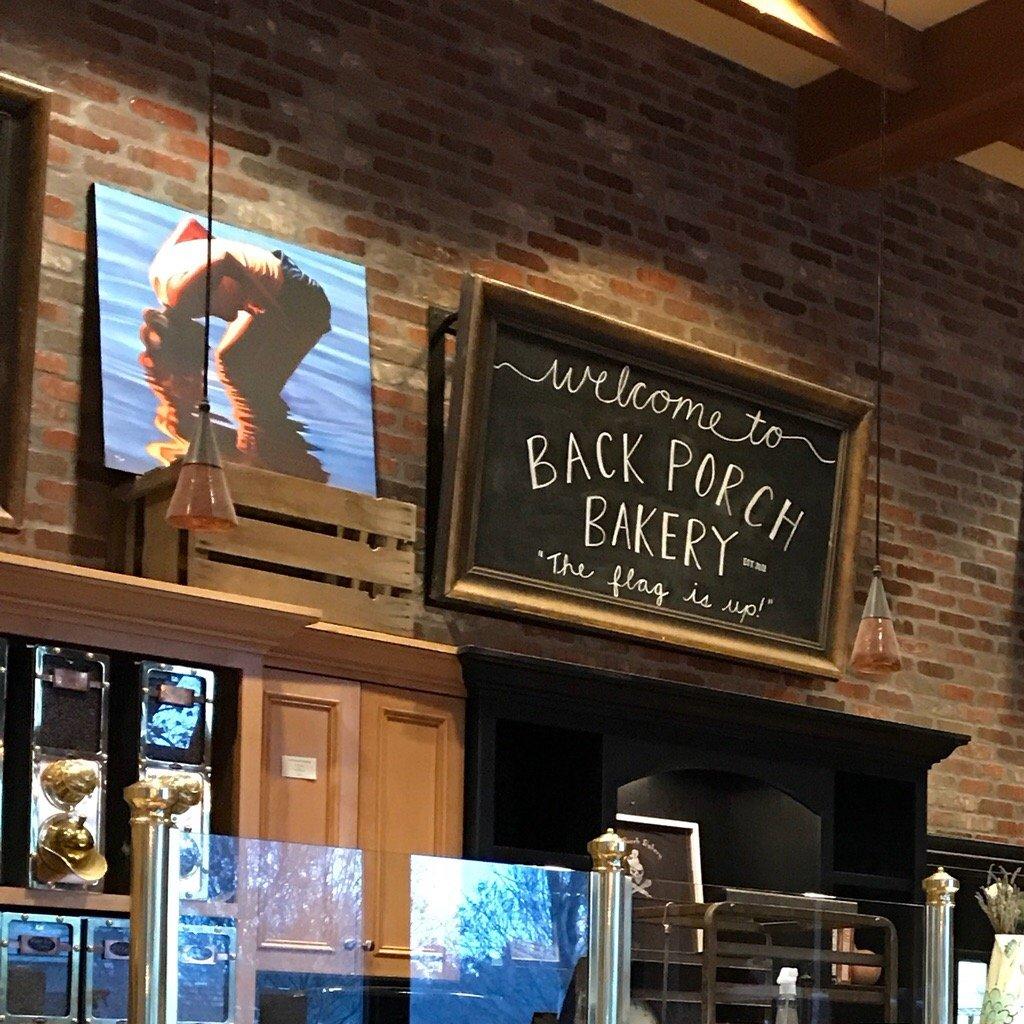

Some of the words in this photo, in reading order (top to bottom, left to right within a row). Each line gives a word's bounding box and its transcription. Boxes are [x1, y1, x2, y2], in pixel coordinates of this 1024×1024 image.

[540, 358, 728, 432] welcome
[745, 409, 793, 450] to
[526, 431, 645, 490] BACK
[667, 438, 805, 552] PORCH
[584, 494, 739, 577] BAKERY
[606, 564, 670, 607] flag
[682, 582, 713, 609] is
